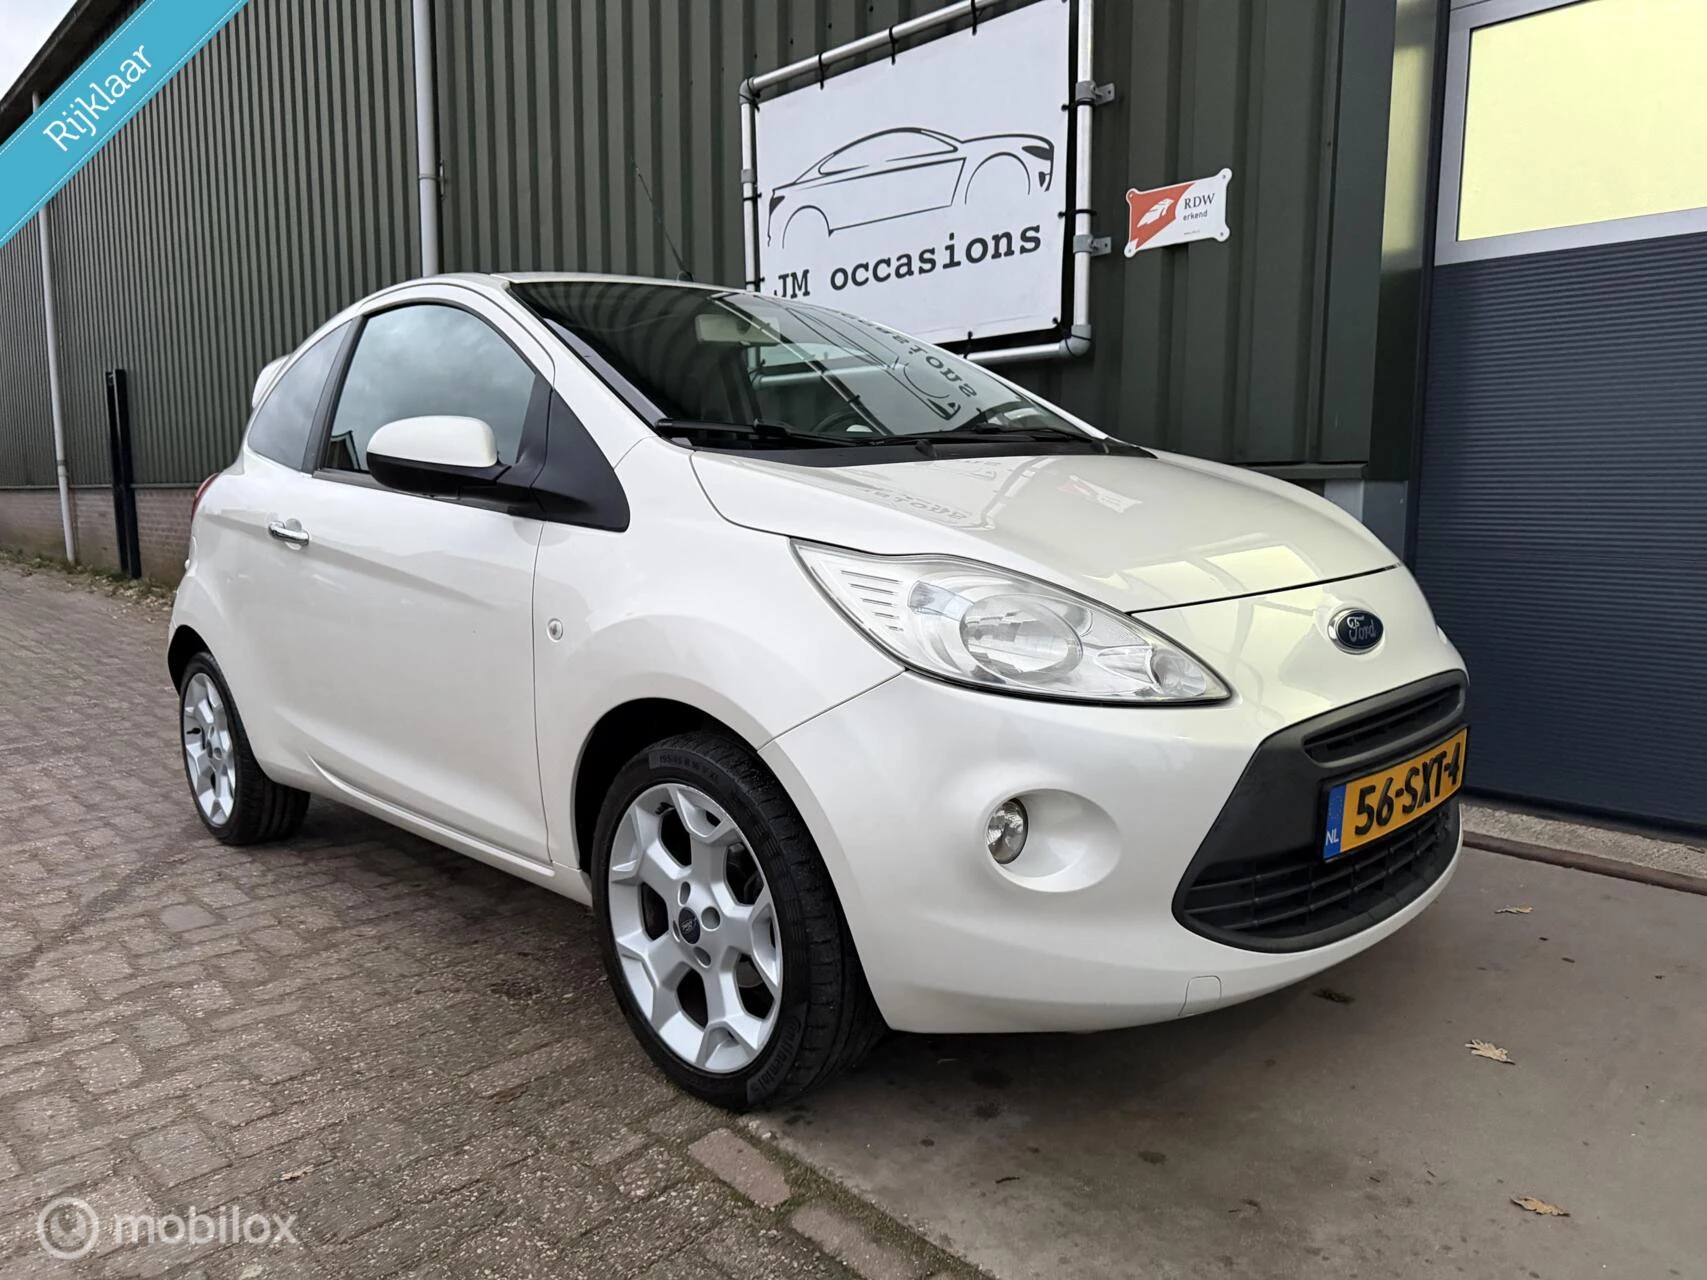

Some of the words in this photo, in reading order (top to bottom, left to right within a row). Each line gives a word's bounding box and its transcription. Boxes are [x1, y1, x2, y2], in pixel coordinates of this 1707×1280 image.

[1184, 192, 1216, 210] RDW
[1183, 209, 1208, 221] erkend
[773, 268, 811, 300] JM
[830, 224, 1042, 291] occasions
[1346, 615, 1376, 642] Ford
[1325, 828, 1340, 847] NL
[1354, 742, 1461, 836] 56-SXT-4
